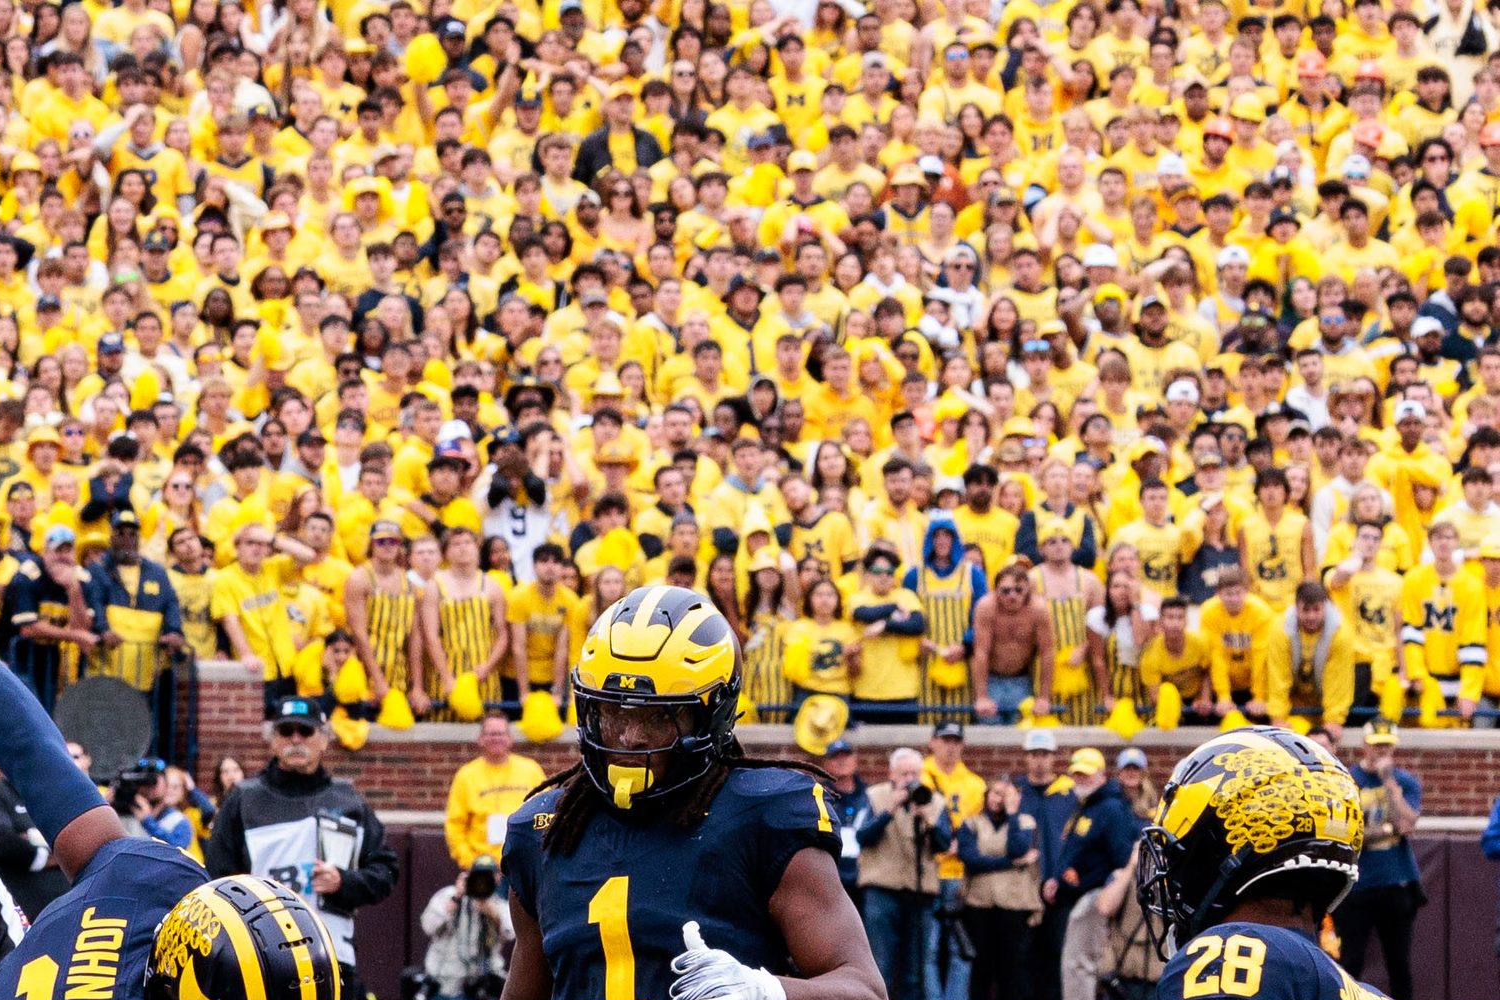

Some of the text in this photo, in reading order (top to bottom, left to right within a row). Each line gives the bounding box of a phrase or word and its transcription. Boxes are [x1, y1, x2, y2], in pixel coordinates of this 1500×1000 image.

[1423, 602, 1457, 632] M
[619, 676, 636, 689] M
[812, 783, 833, 832] 1
[1295, 817, 1313, 833] 28
[1183, 934, 1267, 999] 28
